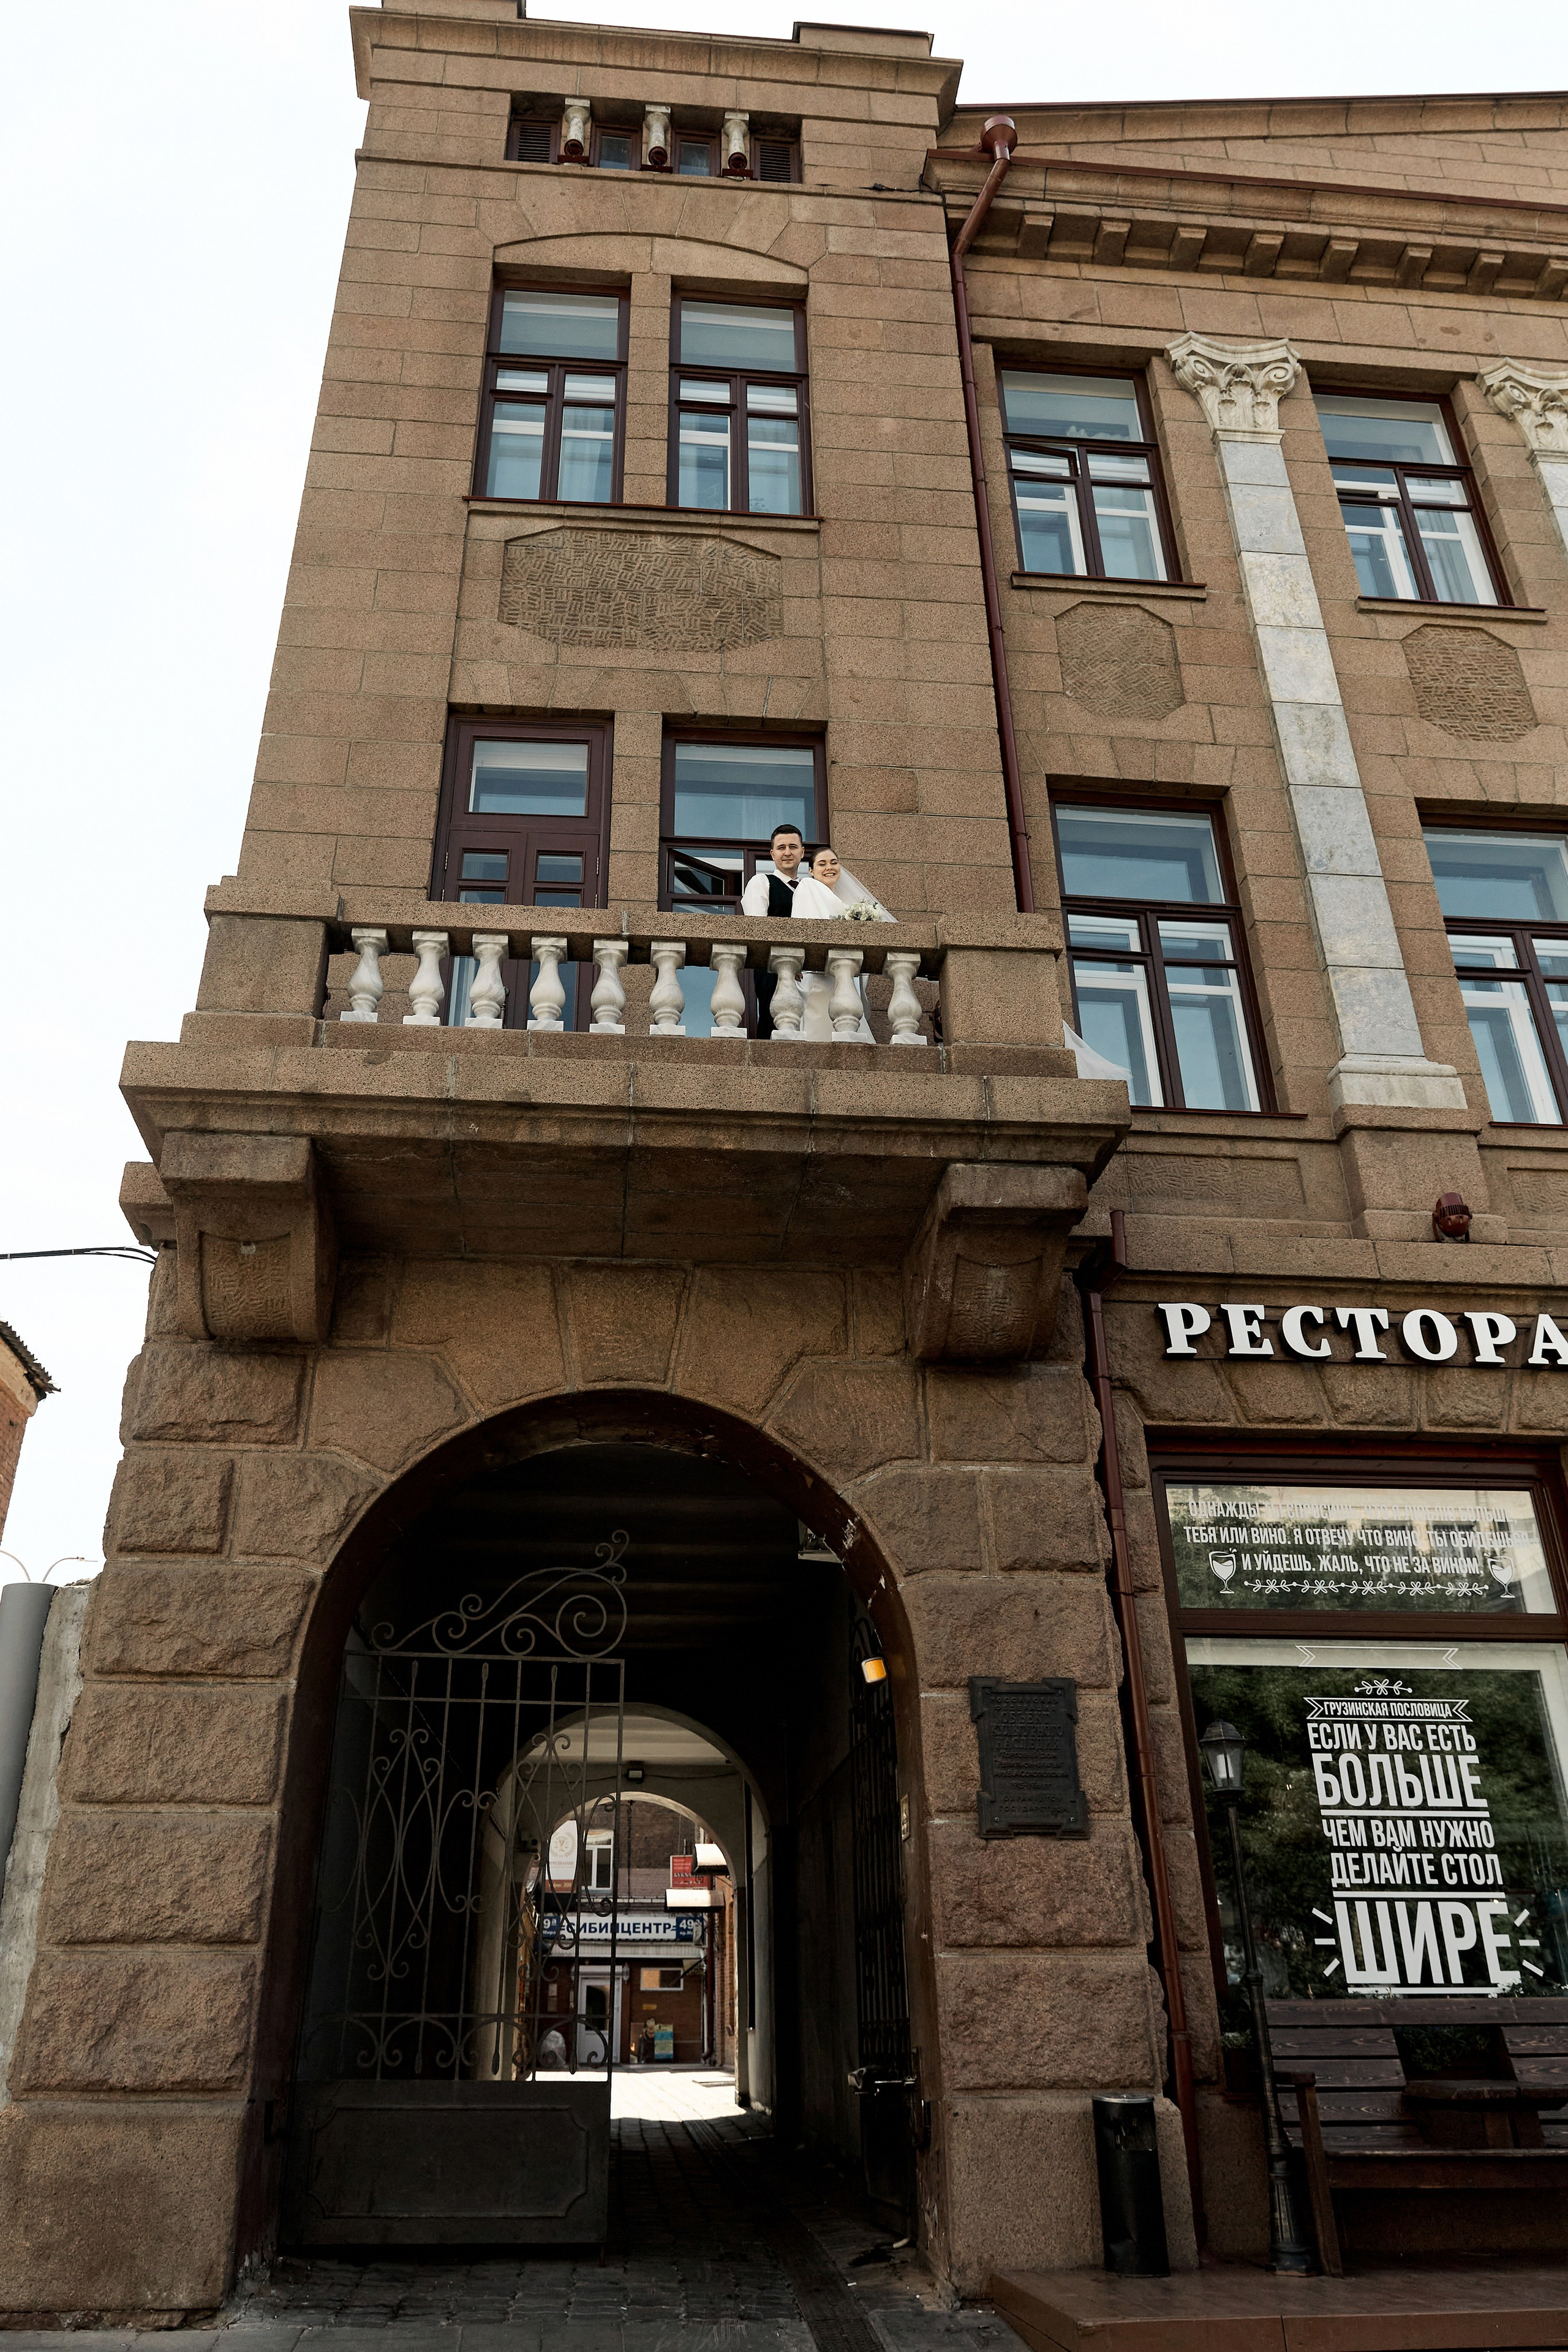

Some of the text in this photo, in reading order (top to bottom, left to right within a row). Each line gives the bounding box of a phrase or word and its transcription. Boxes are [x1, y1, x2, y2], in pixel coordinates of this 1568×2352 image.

[1157, 1302, 1568, 1365] РЕСТОРА
[1188, 1501, 1261, 1520] ОДНАЖДЫ
[1264, 1502, 1284, 1519] ТЫ
[1403, 1504, 1456, 1522] ЛЮБЛЮ
[1183, 1526, 1218, 1544] ТЕБЯ
[1219, 1527, 1249, 1544] ИЛИ
[1251, 1527, 1292, 1545] ВИНО.
[1294, 1528, 1303, 1545] Я
[1305, 1528, 1354, 1546] ОТВЕЧУ
[1357, 1529, 1383, 1547] ЧТО
[1426, 1531, 1449, 1548] ТЫ
[1241, 1550, 1484, 1575] И УЙДЕШЬ. ЖАЛЬ, ЧТО НЕ ЗА ВИНОМ.
[1323, 1701, 1453, 1719] ГРУЗИНСКАЯ ПОСЛОВИЦА
[1306, 1722, 1477, 1752] ЕСЛИ У ВАС ЕСТЬ
[1311, 1752, 1488, 1807] БОЛЬШЕ
[1321, 1819, 1496, 1849] ЧЕМ ВАМ НУЖНО
[1330, 1845, 1504, 1888] ДЕЛАЙТЕ СТОЛ
[1333, 1900, 1522, 1985] ШИРЕ
